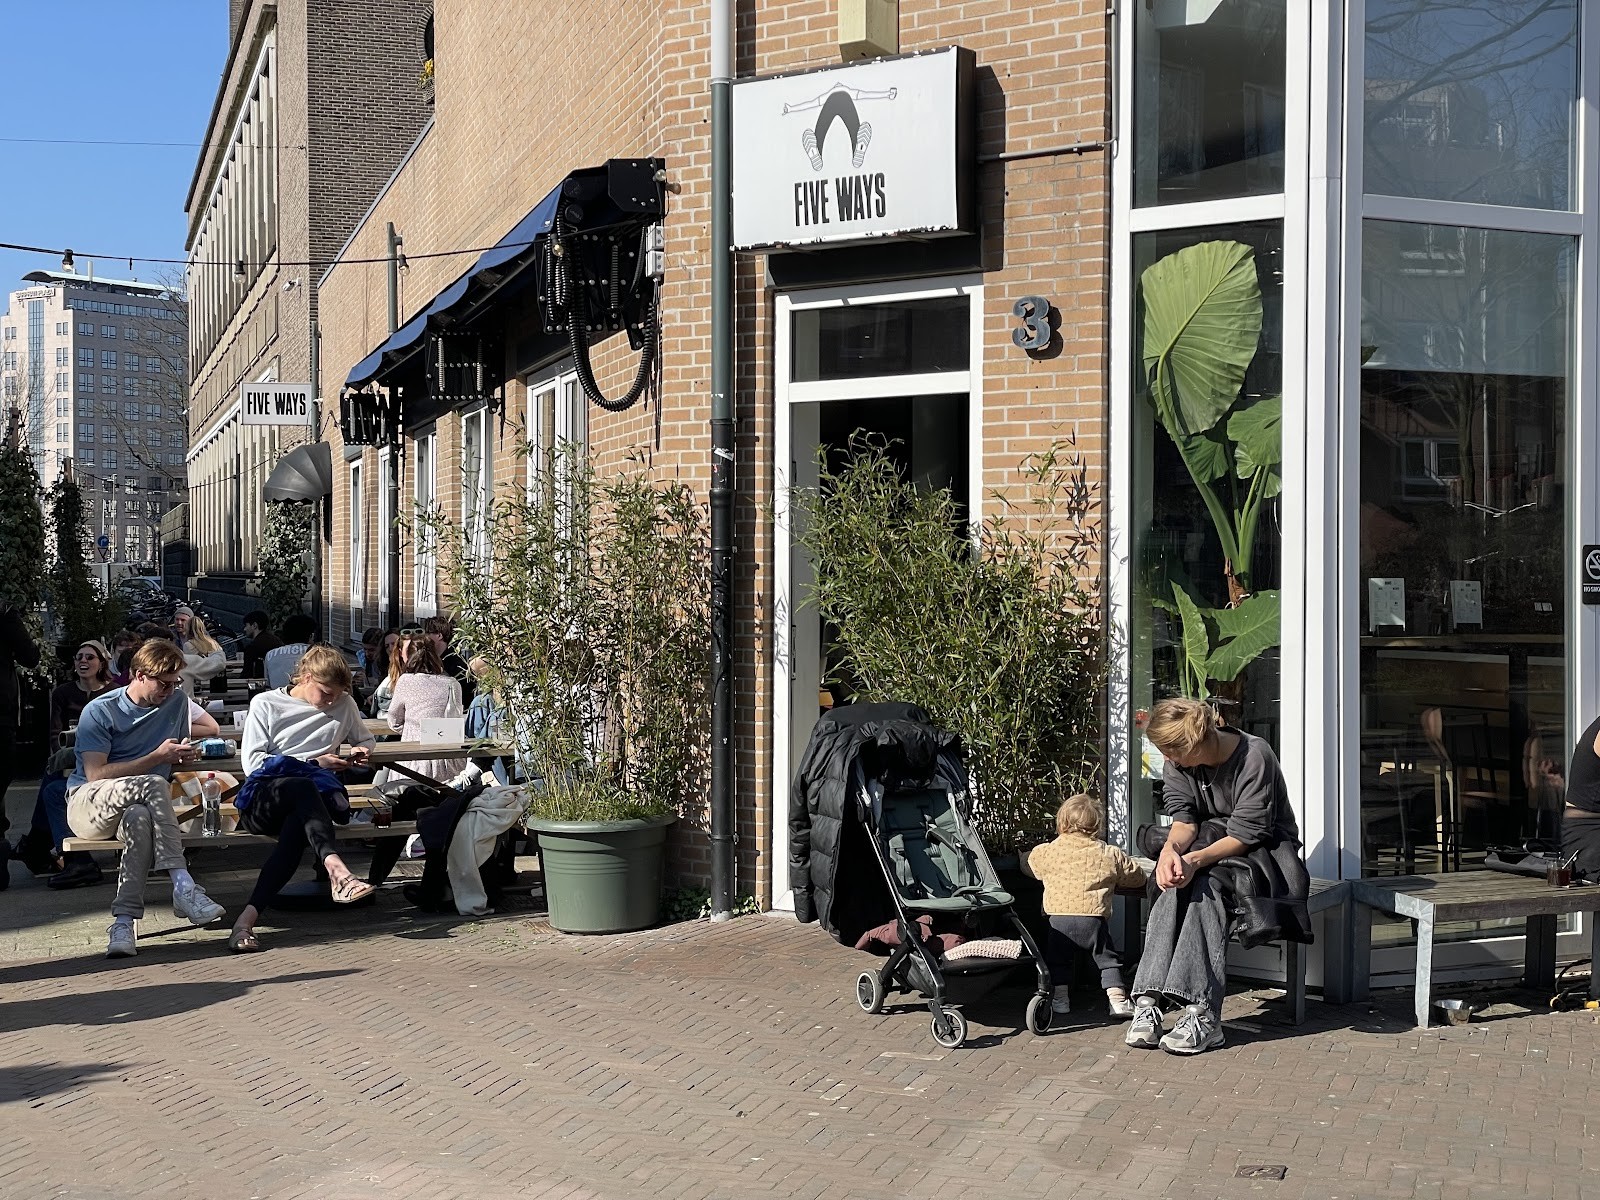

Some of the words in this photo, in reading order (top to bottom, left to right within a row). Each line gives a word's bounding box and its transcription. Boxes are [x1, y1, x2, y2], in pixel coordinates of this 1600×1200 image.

[795, 179, 829, 226] FIVE
[835, 172, 886, 222] WAYS
[1012, 296, 1050, 349] 3
[247, 391, 270, 415] FIVE
[274, 392, 306, 416] WAYS
